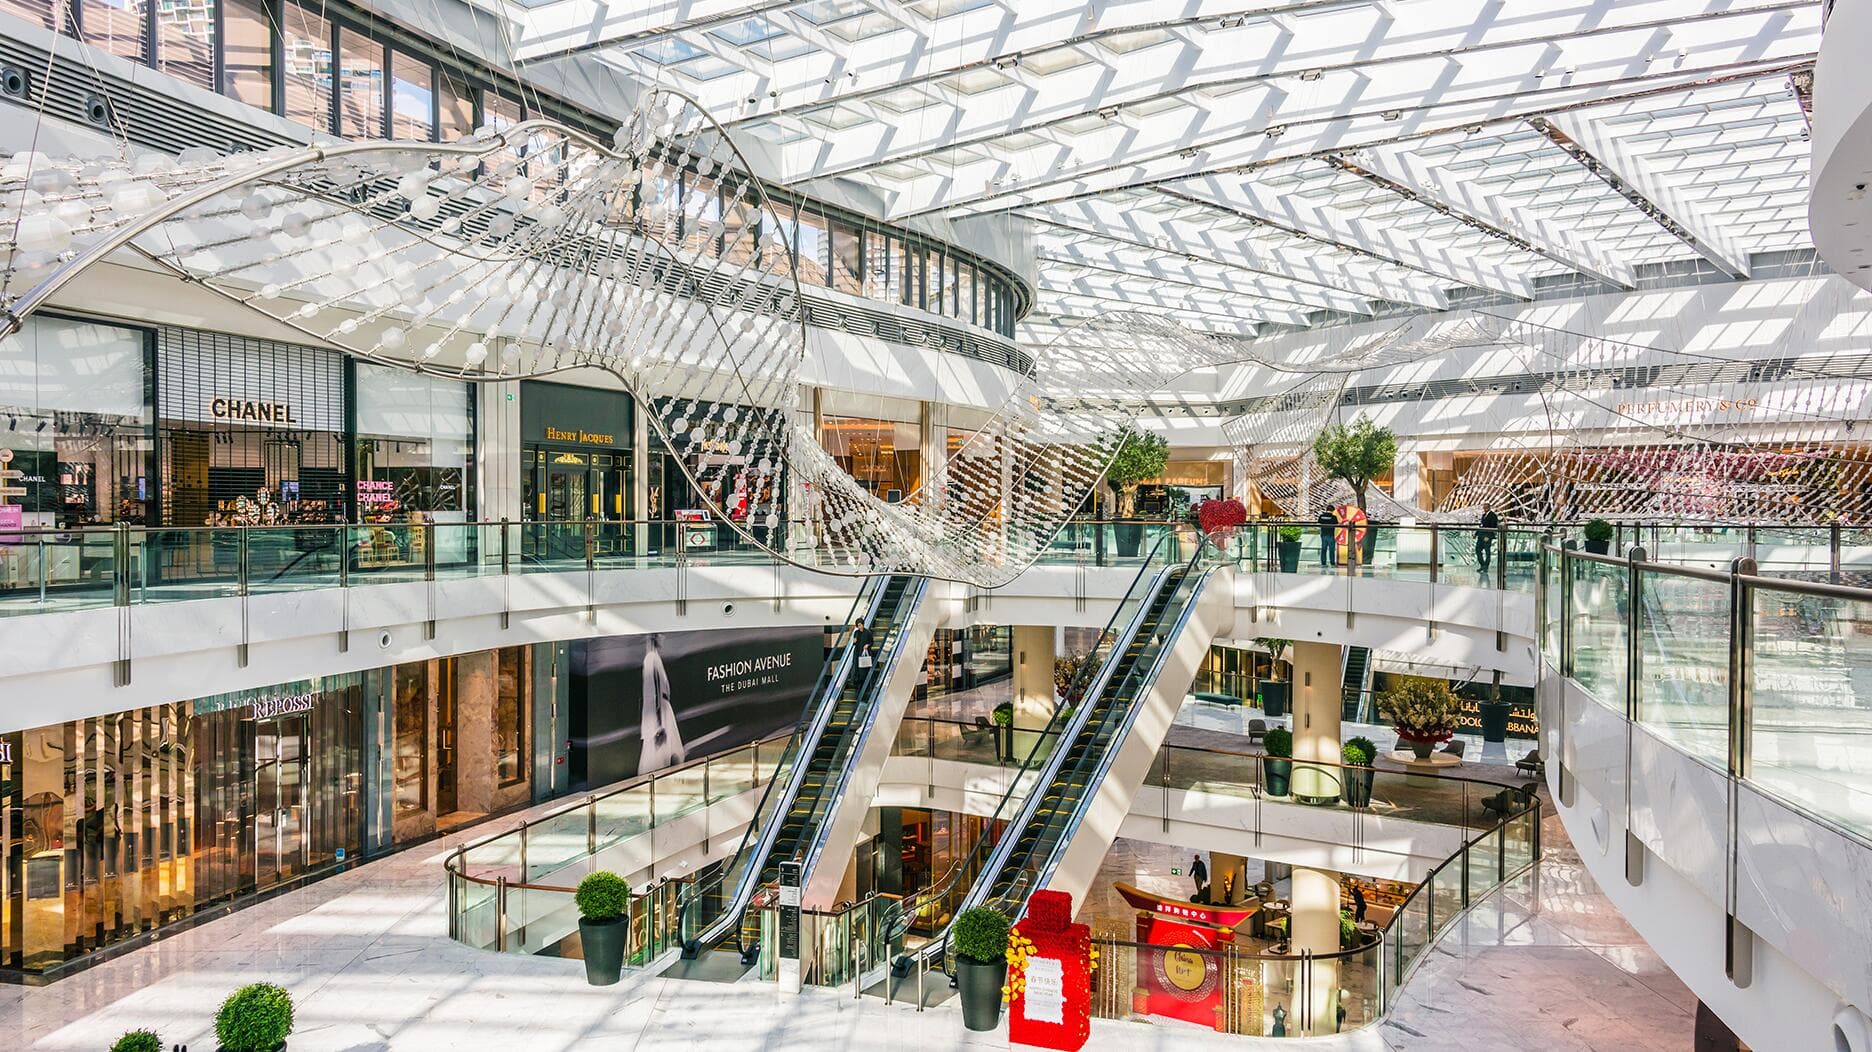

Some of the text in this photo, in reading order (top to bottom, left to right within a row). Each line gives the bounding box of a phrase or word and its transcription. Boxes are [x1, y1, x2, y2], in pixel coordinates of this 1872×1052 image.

[211, 398, 297, 423] CHANEL
[1719, 399, 1730, 411] &
[19, 475, 46, 483] CHANEL
[356, 480, 394, 491] CHANCE
[356, 492, 394, 502] CHANEL
[707, 653, 792, 682] FASHION AVENUE
[721, 674, 779, 694] THE DUBAI MALL
[253, 693, 313, 720] REPOSSI
